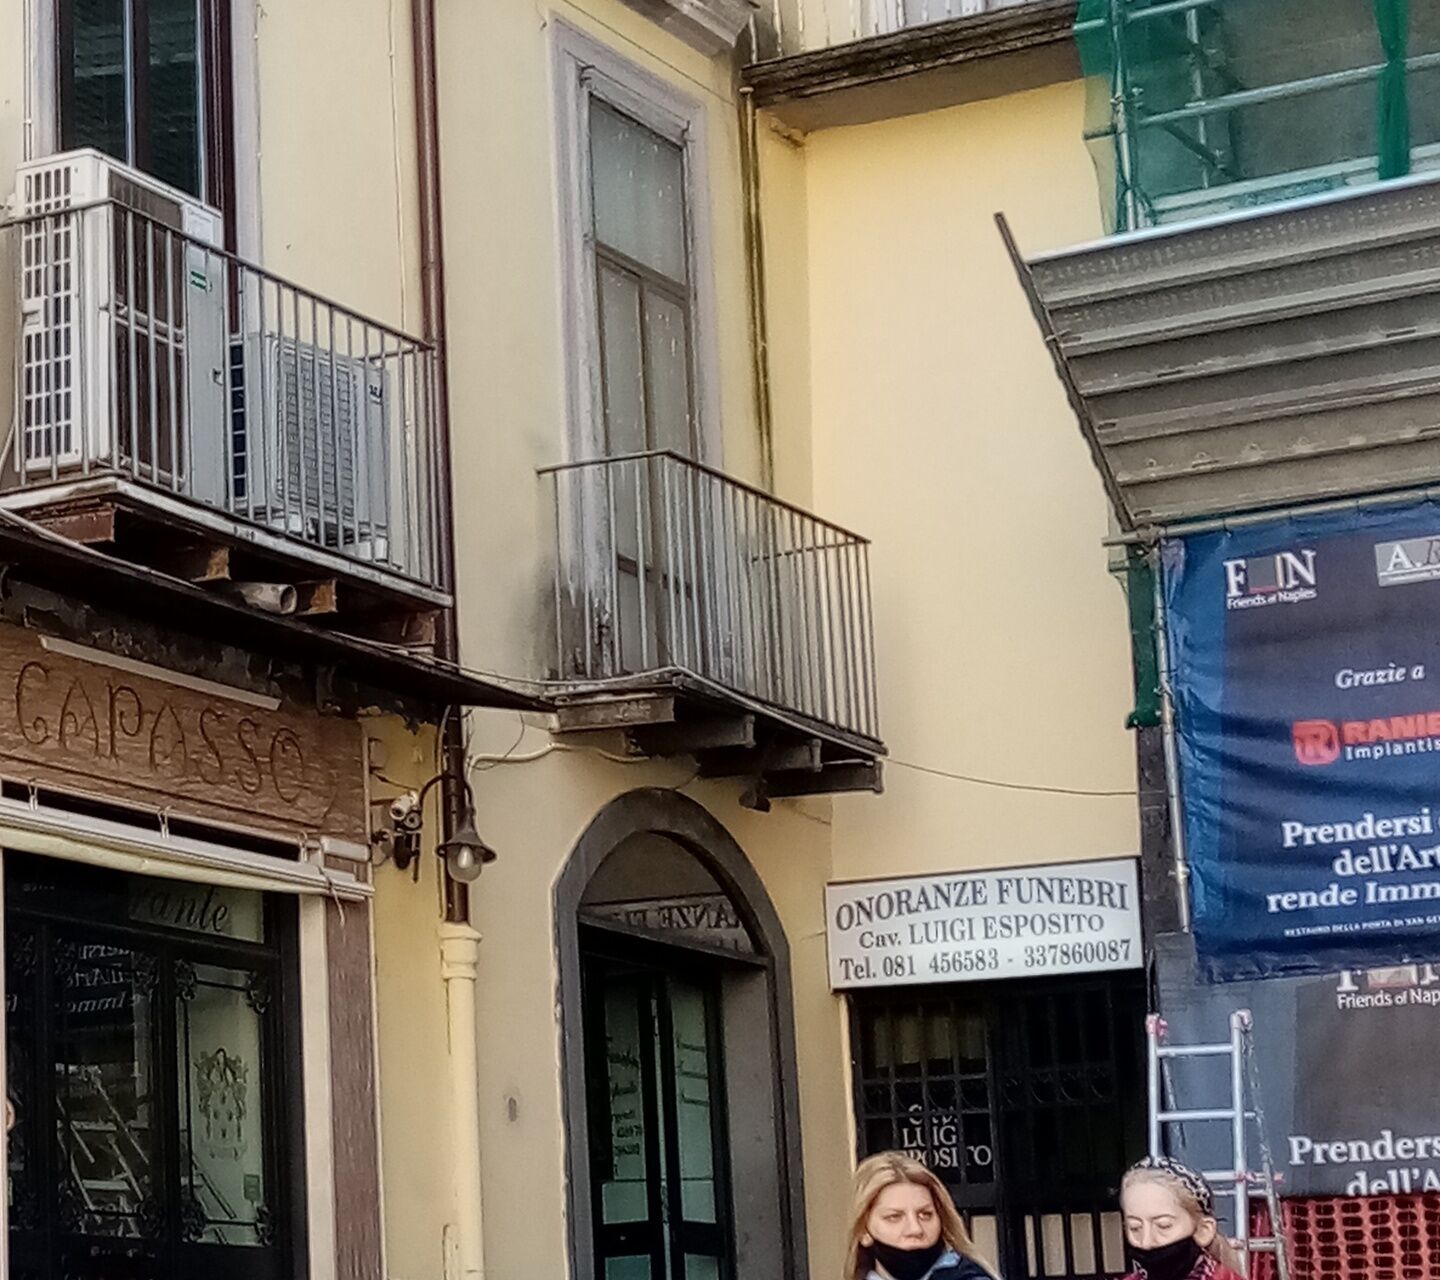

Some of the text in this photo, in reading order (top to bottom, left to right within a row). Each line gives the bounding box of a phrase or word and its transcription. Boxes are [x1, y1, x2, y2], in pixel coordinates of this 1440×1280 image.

[1226, 594, 1267, 611] Friends
[1277, 587, 1318, 604] Naples
[1334, 663, 1426, 691] Grazie a
[1281, 807, 1433, 849] Prendersi
[835, 876, 1131, 933] ONORANZE FUNEBRI
[1266, 882, 1358, 914] rende
[859, 913, 1106, 950] Cav. LUIGI ESPOSITO
[839, 957, 878, 981] Tel.
[882, 954, 917, 978] 081
[928, 948, 1000, 974] 456583
[1023, 938, 1133, 969] 337860087
[1336, 990, 1392, 1010] Friends
[1394, 990, 1408, 1005] of
